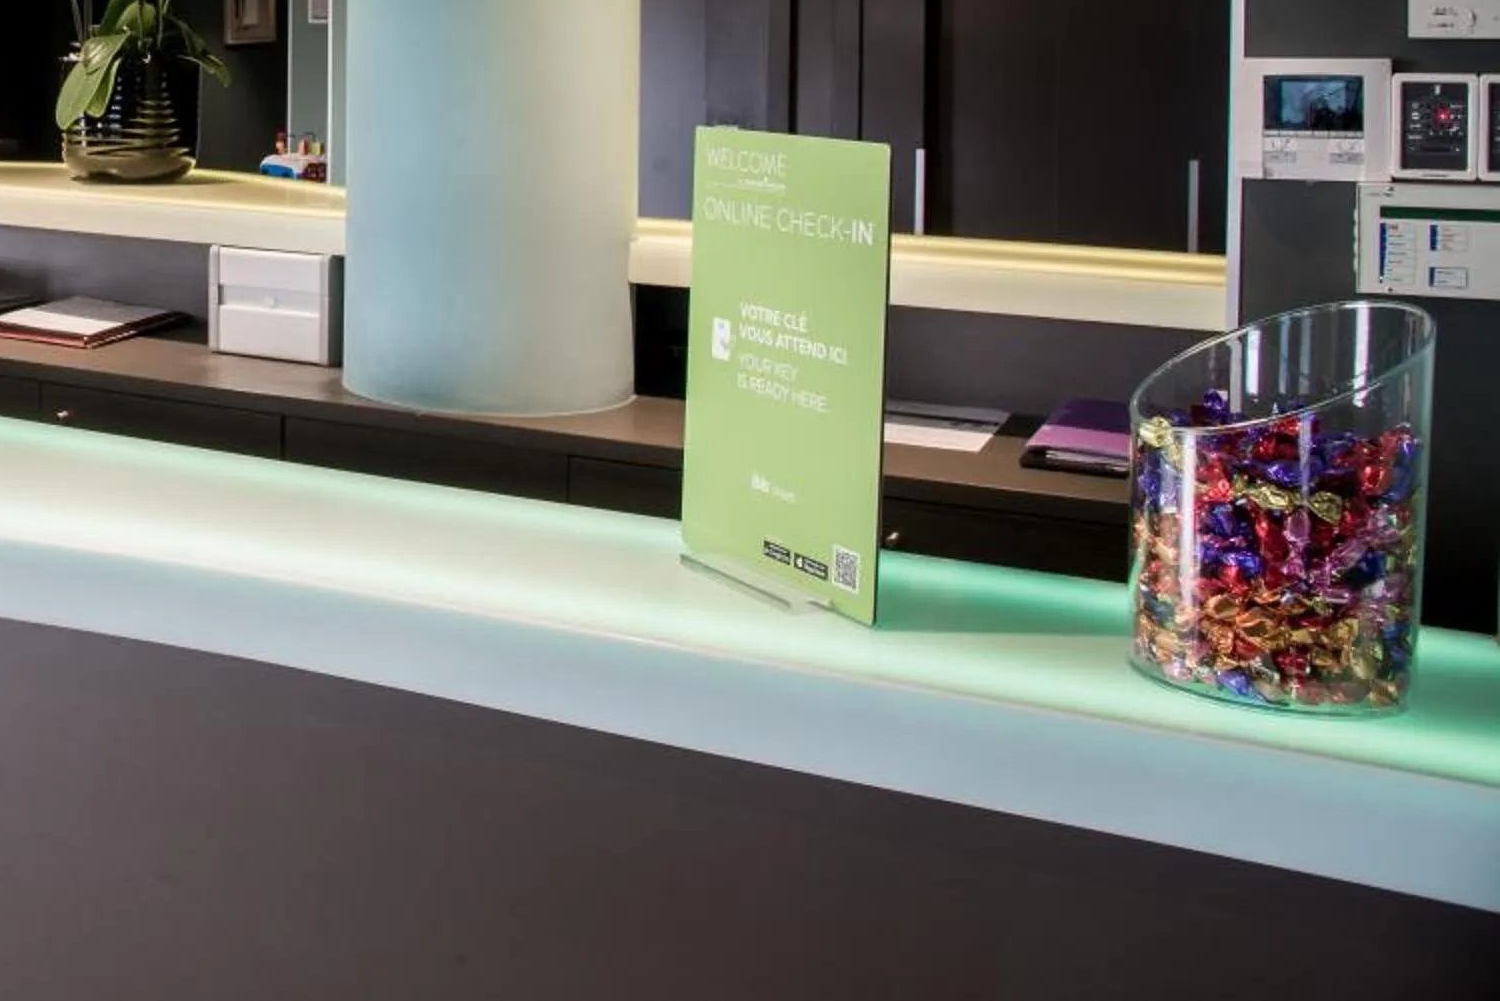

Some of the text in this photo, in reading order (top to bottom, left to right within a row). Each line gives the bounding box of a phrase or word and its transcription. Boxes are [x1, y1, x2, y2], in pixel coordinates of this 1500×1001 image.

[707, 148, 787, 177] WELCOME
[703, 196, 873, 246] ONLINE CHECK-IN
[739, 302, 808, 333] VOTRE CLÉ
[739, 323, 773, 345] VOUS
[775, 333, 826, 358] ATTEND
[739, 354, 799, 382] YOUR KEY
[749, 376, 789, 402] READY
